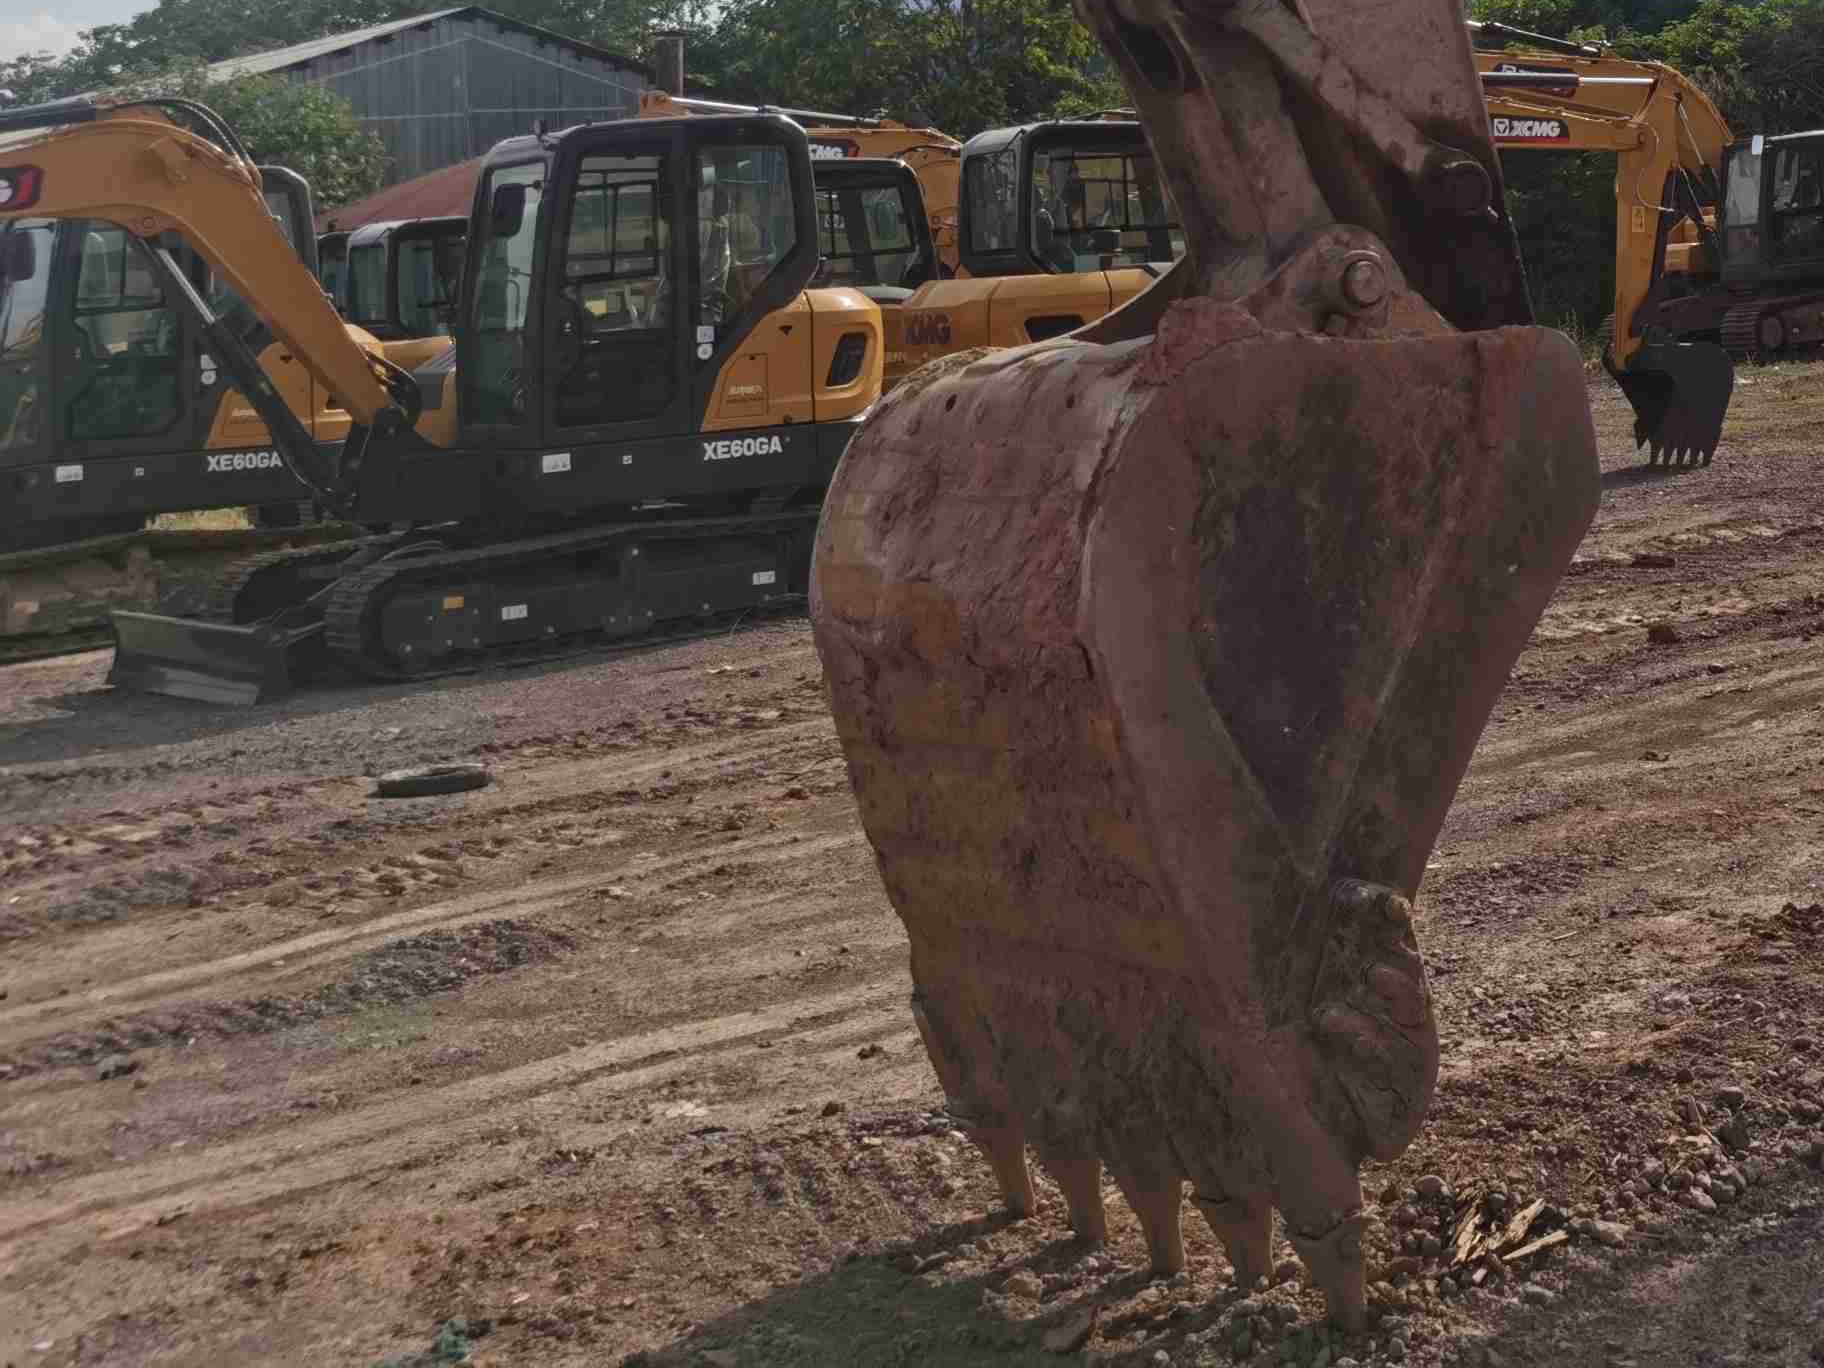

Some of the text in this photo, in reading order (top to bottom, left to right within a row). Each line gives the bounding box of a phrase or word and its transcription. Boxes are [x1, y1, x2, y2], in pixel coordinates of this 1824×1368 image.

[1511, 120, 1560, 137] XCMG
[704, 435, 783, 460] XE60GA
[207, 450, 283, 472] XE60GA
